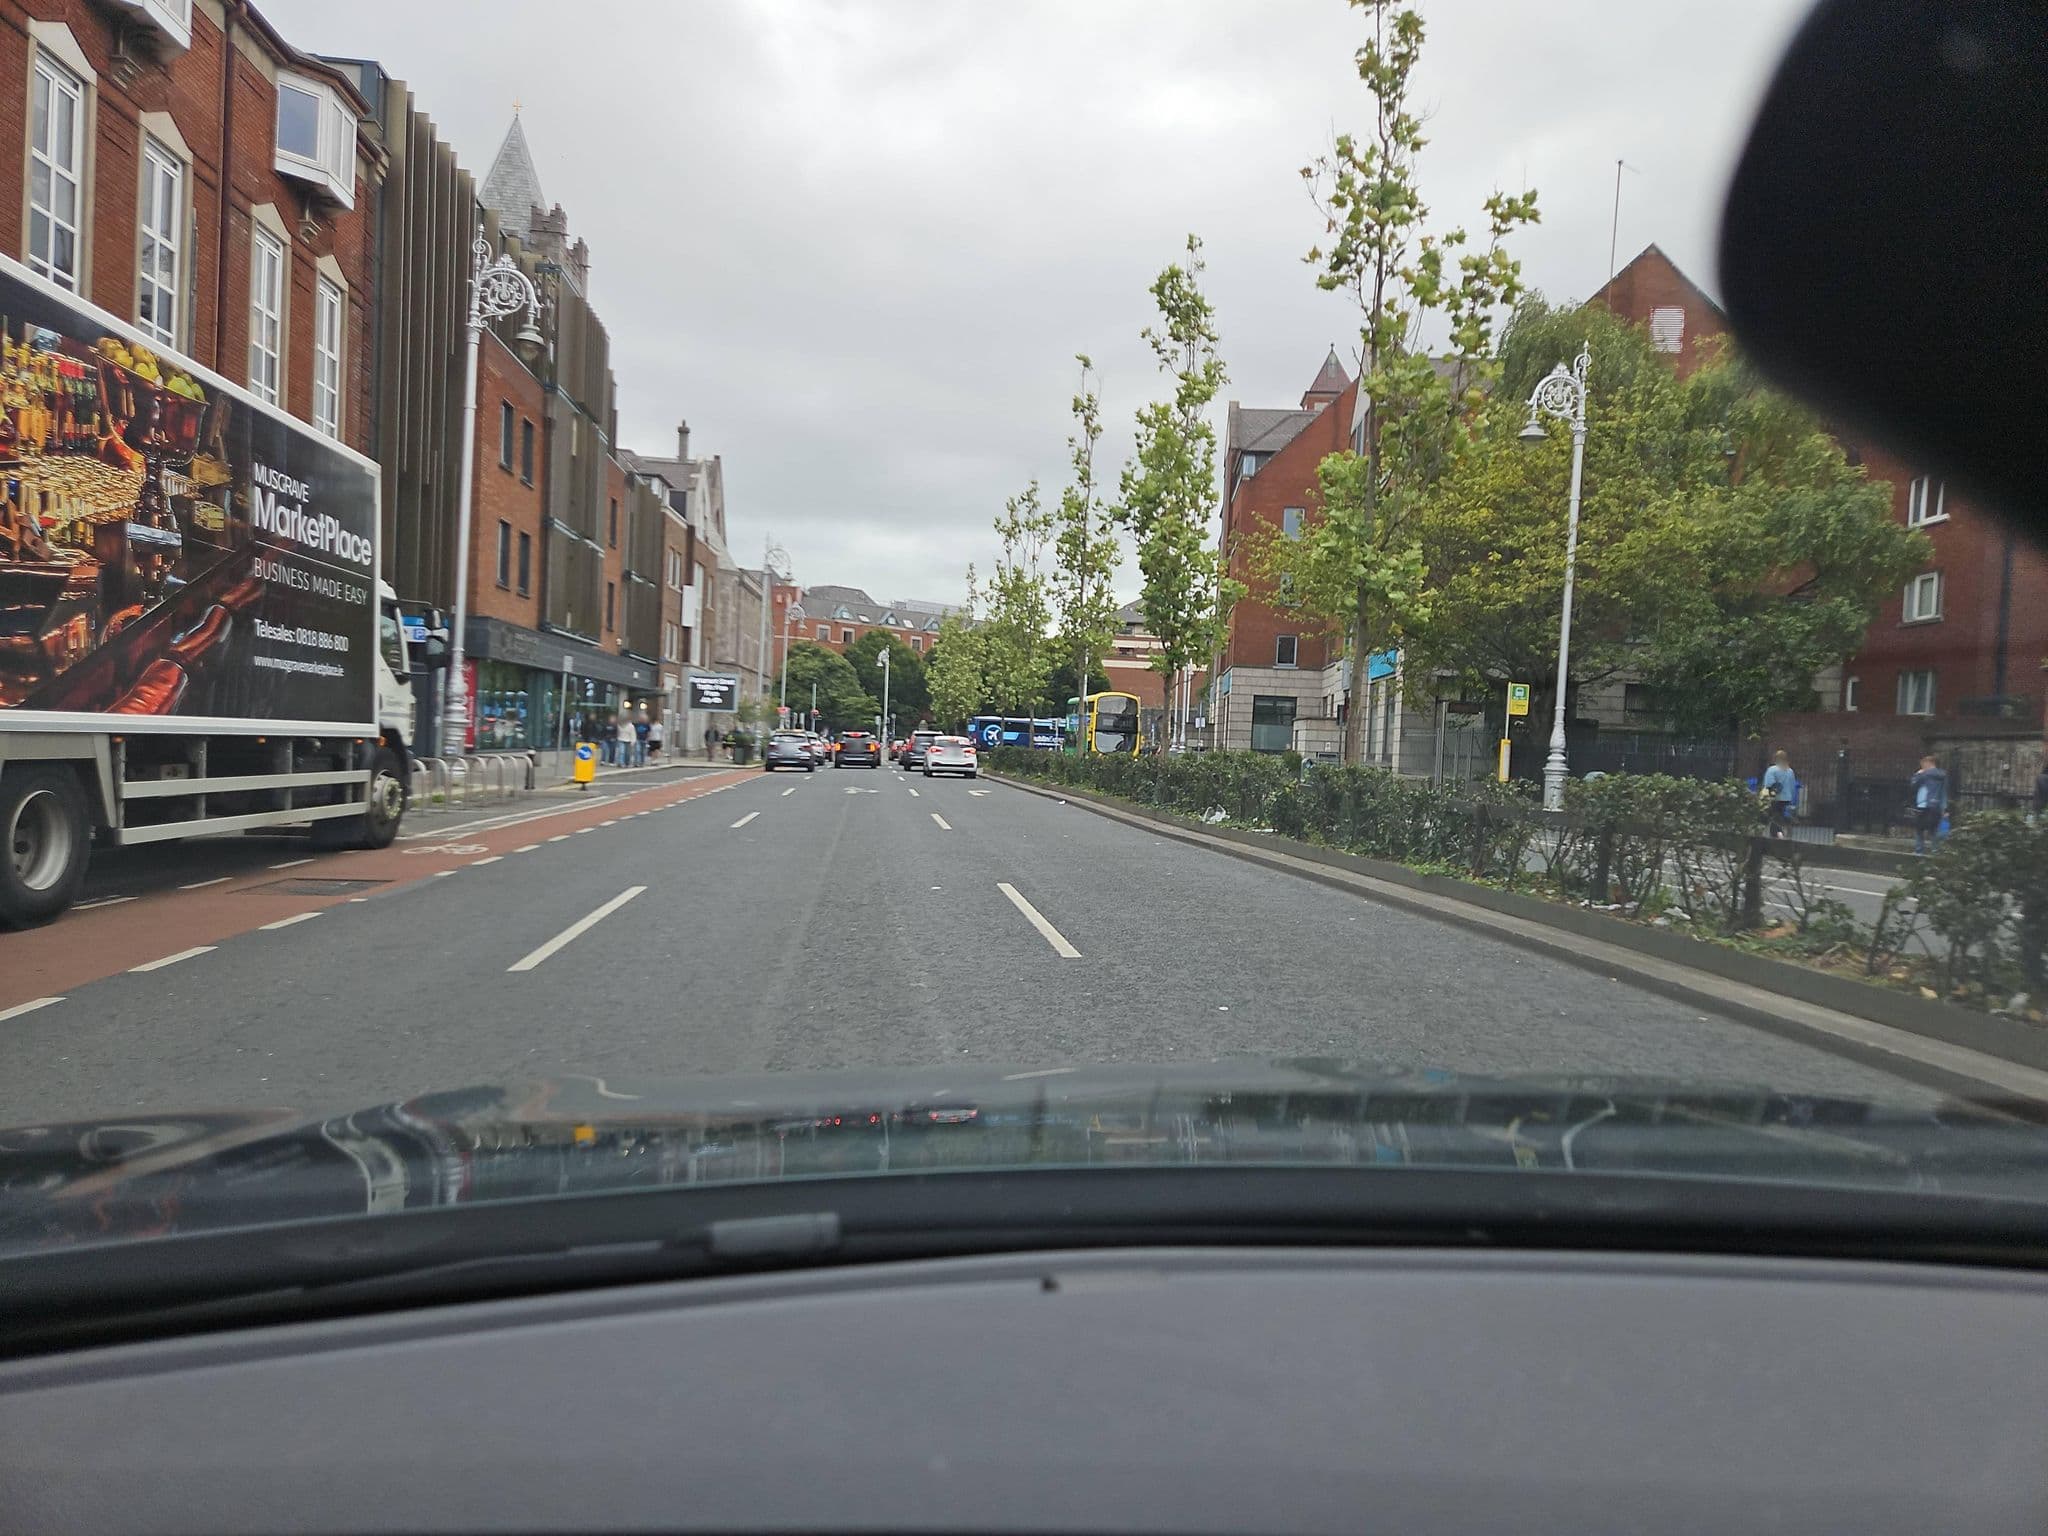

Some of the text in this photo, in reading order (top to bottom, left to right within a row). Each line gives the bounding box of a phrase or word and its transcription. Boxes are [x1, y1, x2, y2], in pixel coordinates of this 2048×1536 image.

[254, 462, 310, 503] MUSGRAVE
[254, 486, 373, 567] MarketPlace
[254, 557, 368, 606] BUSINESS MADE EASY
[254, 618, 349, 652] Telesales: 0818 886 800
